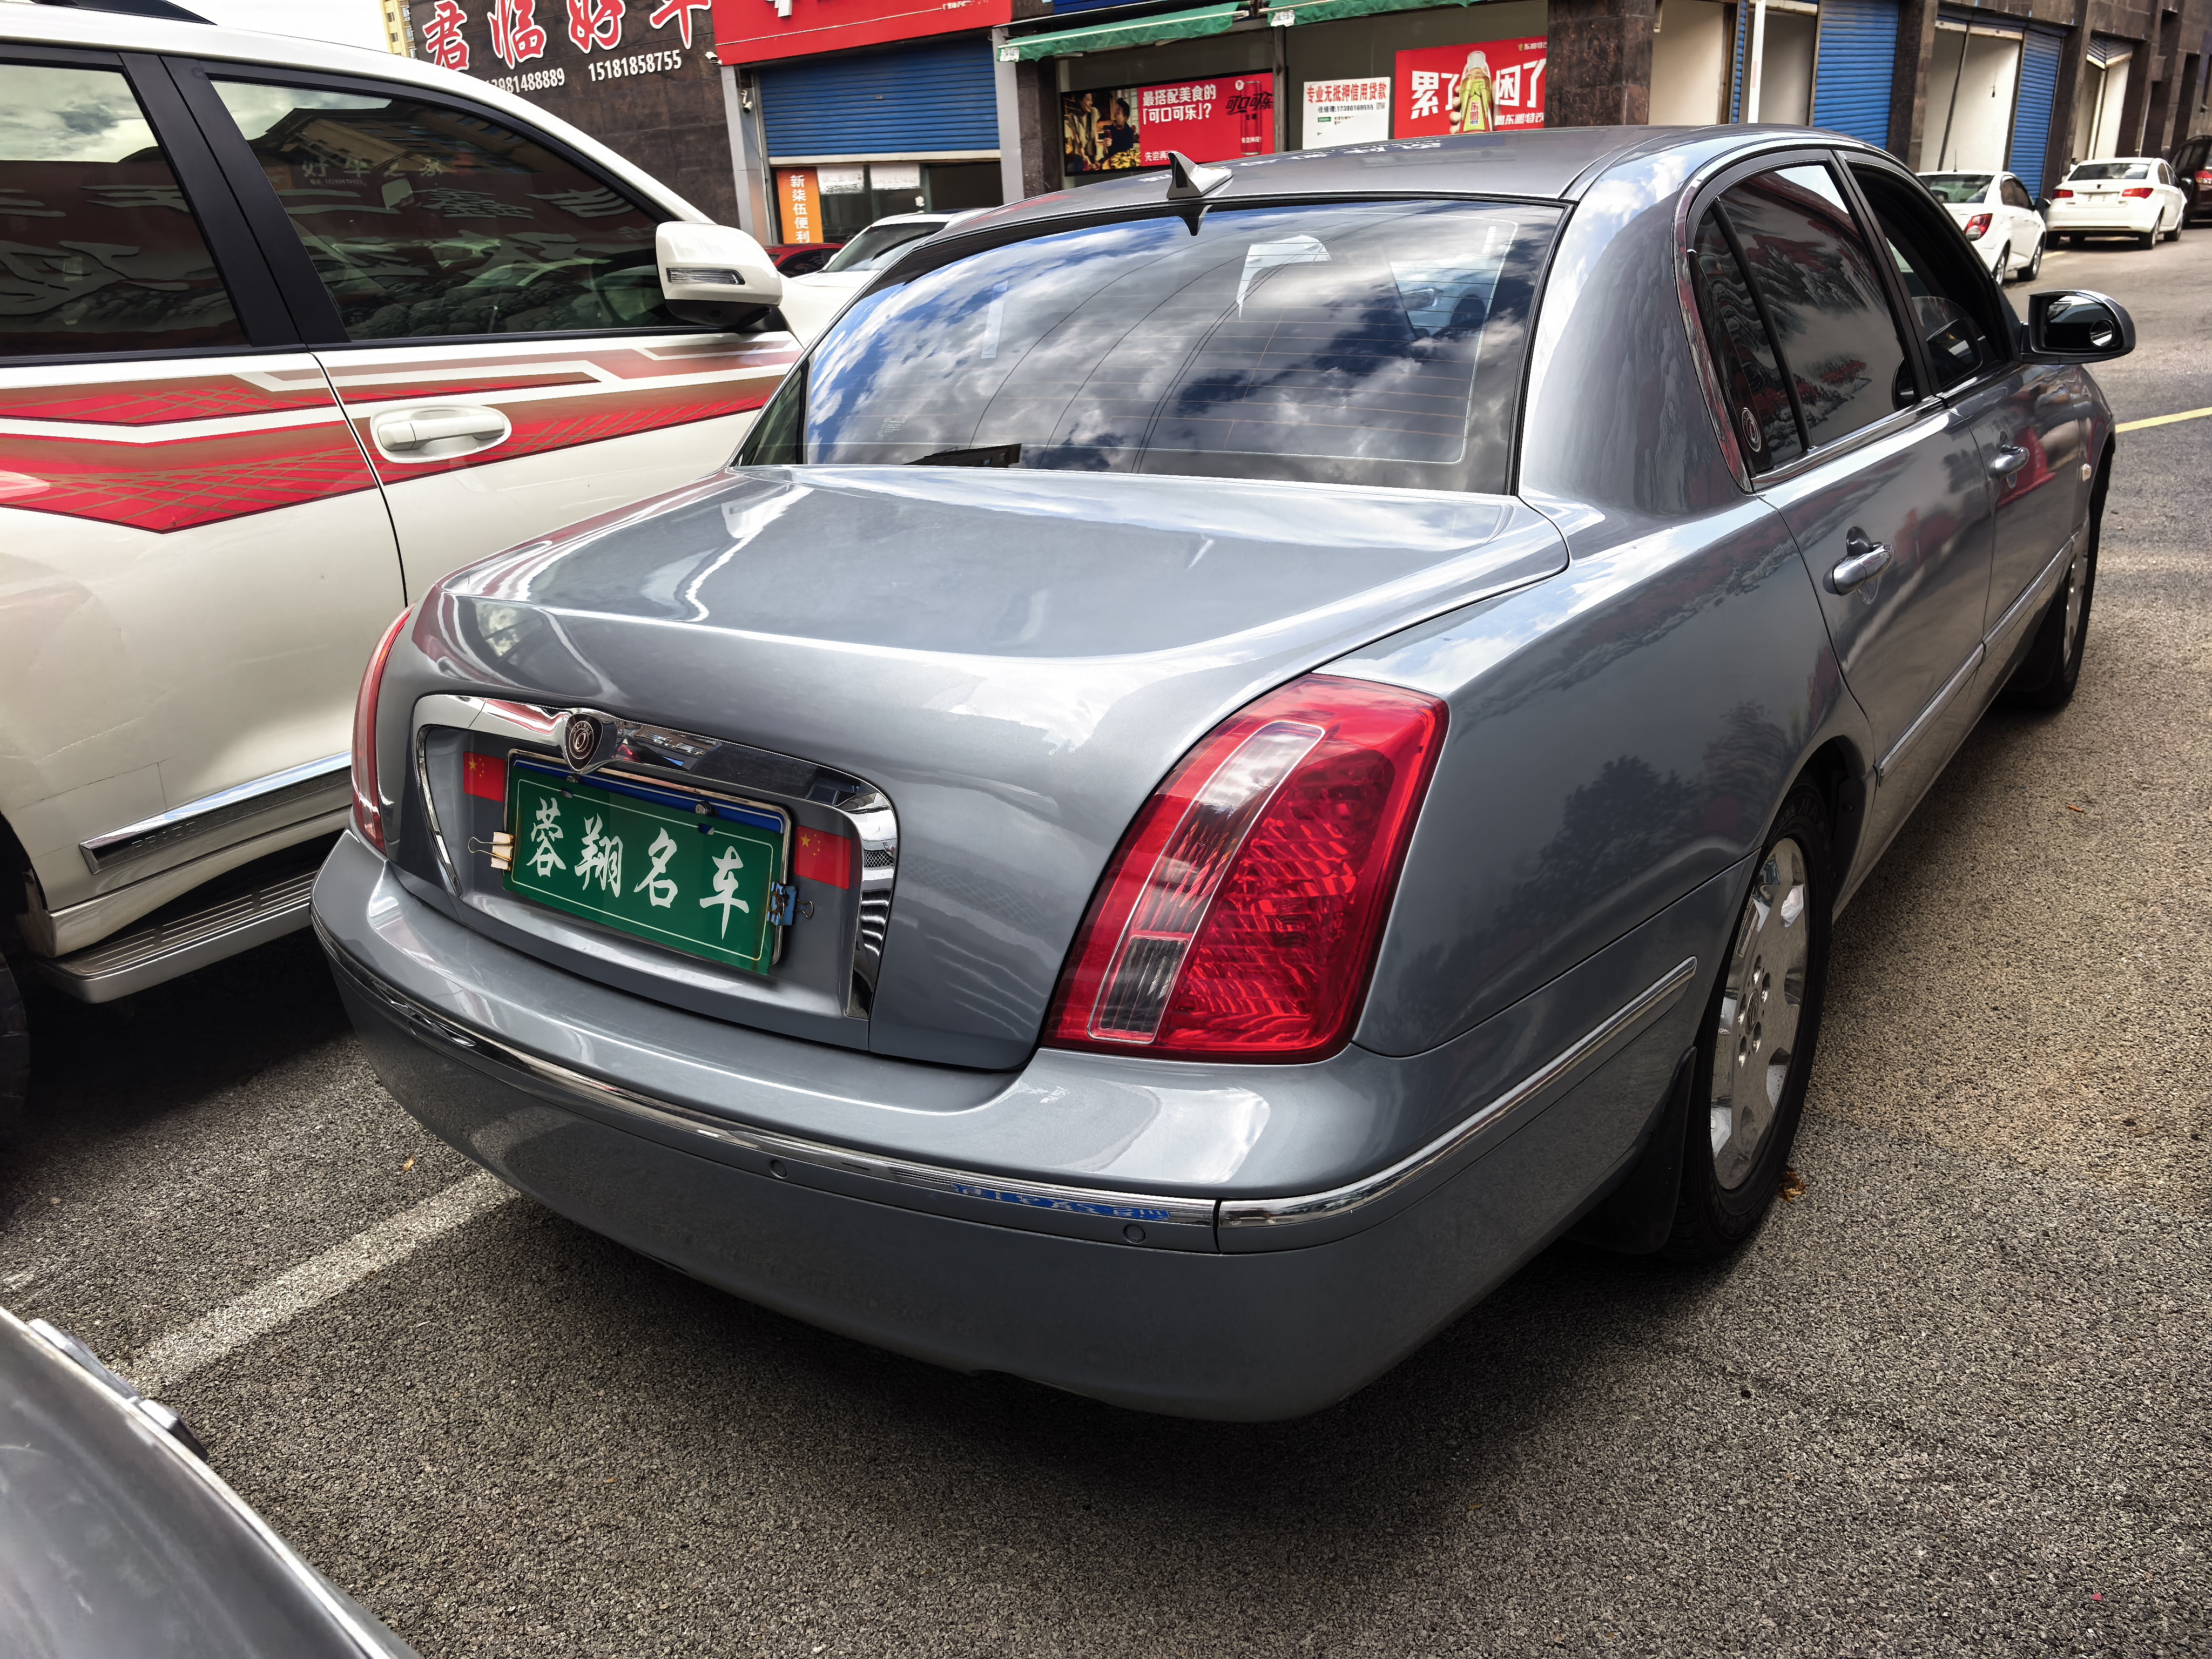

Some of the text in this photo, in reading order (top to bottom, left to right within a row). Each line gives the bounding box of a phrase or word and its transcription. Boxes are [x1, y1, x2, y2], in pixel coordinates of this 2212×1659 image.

[487, 49, 682, 93] 981488889 15181858755
[1306, 82, 1387, 103] 专业无抵押信用贷款
[1411, 58, 1547, 119] 累了 困了
[1143, 84, 1217, 106] 最搭配美食的
[789, 174, 811, 244] 新柒伍便利
[574, 724, 592, 736] OPIRUS
[525, 797, 750, 940] 蓉翔名车
